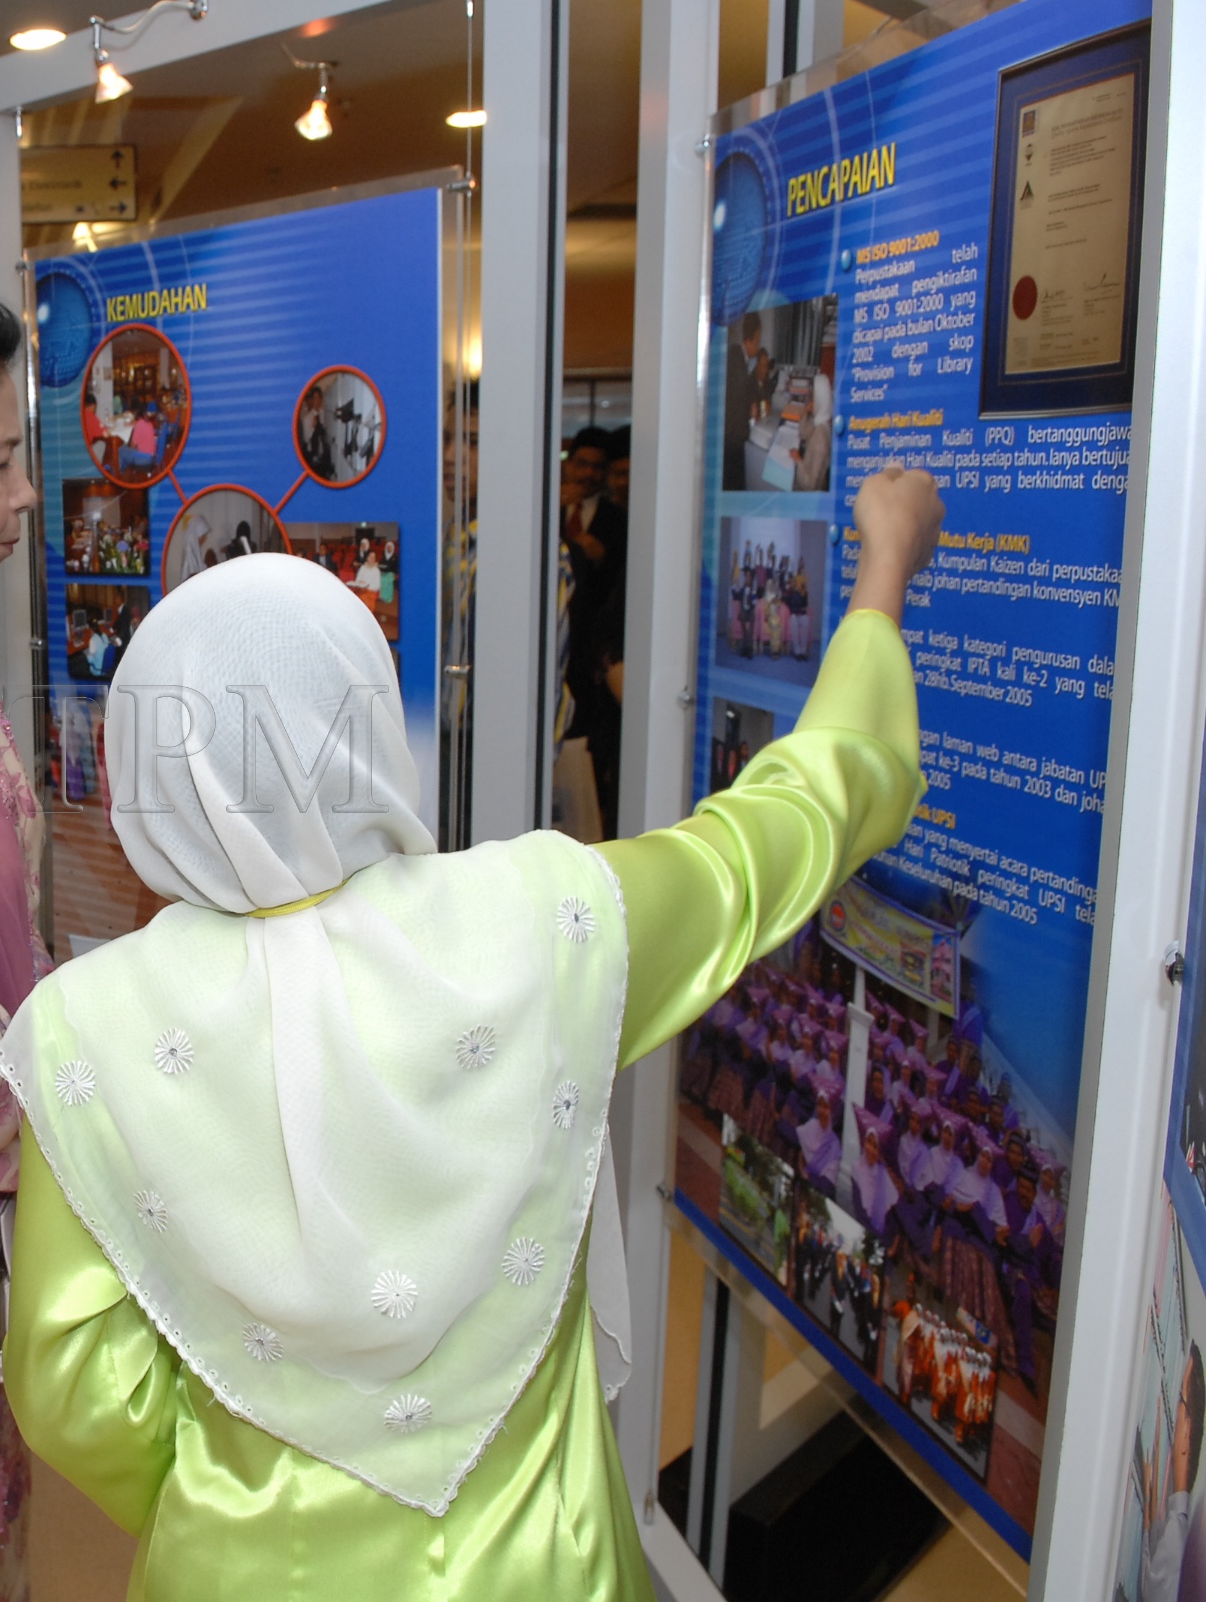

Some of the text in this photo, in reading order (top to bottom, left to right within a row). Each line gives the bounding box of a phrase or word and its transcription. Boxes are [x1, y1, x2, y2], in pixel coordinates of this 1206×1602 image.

[786, 141, 897, 218] PENCAPAIAN
[855, 242, 979, 285] Perpustakaan telah
[856, 230, 940, 264] MS ISO 9001:2000
[106, 282, 207, 322] KEMUDAHAN
[854, 266, 978, 304] mendapat pengiktirafan
[854, 290, 976, 324] MS ISO 9001:2000 yang
[853, 310, 976, 345] dicapai pada bulan Oktober
[891, 341, 928, 361] dengan
[948, 334, 974, 353] skop
[908, 358, 923, 378] for
[937, 356, 973, 375] Library
[847, 422, 1131, 451] Pusat Penjaminan Kualiti (PPQ) bertanggungjawa
[906, 452, 925, 468] Hari
[926, 451, 955, 468] Kualiti
[955, 450, 980, 470] pada
[981, 449, 1013, 471] setiap
[956, 471, 980, 489] UPSI
[984, 473, 1012, 494] yang
[1017, 470, 1085, 490] berkhidmat
[938, 531, 1031, 556] Mutu Kerja (KMK)
[938, 552, 987, 574] Kumpulan
[990, 555, 1025, 574] Kaizen
[1028, 558, 1050, 577] dari
[1052, 562, 1122, 584] perpustakaa
[905, 588, 931, 607] Perak
[933, 571, 961, 592] johan
[961, 577, 1031, 602] pertandingan
[1033, 580, 1101, 608] konvensyen
[928, 629, 958, 653] ketiga
[964, 633, 1006, 659] kategori
[1012, 646, 1081, 670] pengurusan
[1088, 654, 1114, 676] dala
[916, 650, 962, 673] peringkat
[967, 657, 990, 677] IPTA
[997, 661, 1016, 681] kali
[1023, 665, 1048, 687] ke-2
[1055, 676, 1085, 699] yang
[1005, 686, 1033, 707] 2005
[943, 731, 974, 755] laman
[976, 743, 1000, 762] web
[1002, 751, 1037, 772] antara
[1040, 756, 1085, 785] jabatan
[1089, 769, 1106, 790] UP
[938, 750, 960, 772] ke-3
[961, 761, 988, 780] pada
[990, 767, 1021, 790] tahun
[1023, 775, 1052, 798] 2003
[1054, 784, 1078, 807] dan
[1080, 790, 1105, 815] joha
[921, 828, 948, 851] yang
[949, 838, 999, 866] menyertai
[999, 856, 1028, 877] acara
[1030, 866, 1097, 905] pertandinga
[953, 880, 978, 901] pada
[979, 888, 1010, 914] tahun
[1011, 900, 1038, 925] 2005
[977, 869, 1029, 900] peringkat
[1038, 887, 1066, 914] UPSI
[1075, 904, 1095, 926] tela
